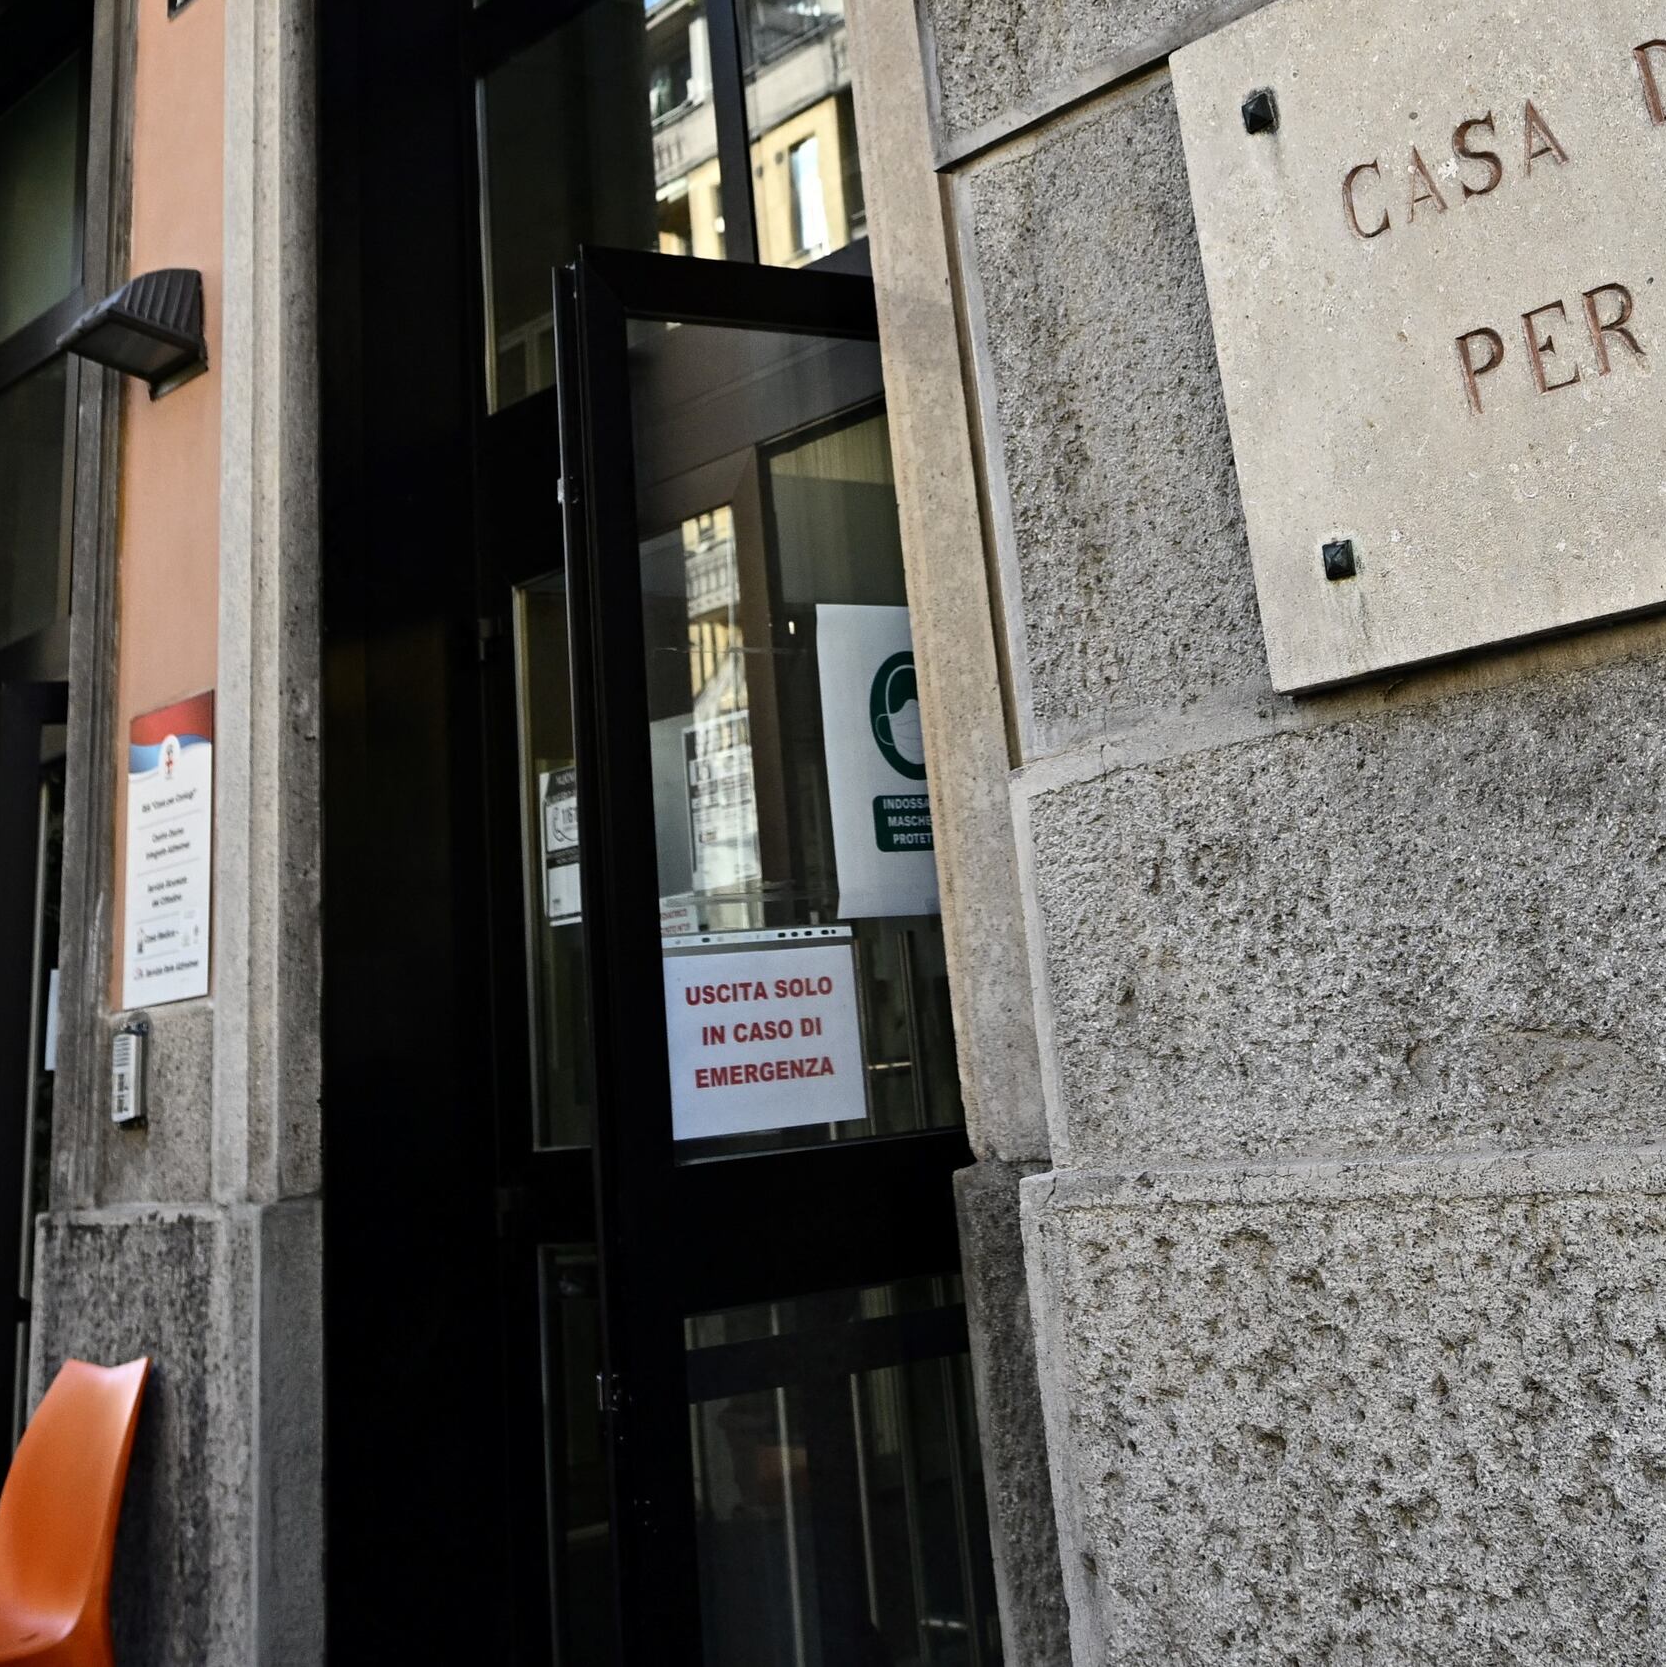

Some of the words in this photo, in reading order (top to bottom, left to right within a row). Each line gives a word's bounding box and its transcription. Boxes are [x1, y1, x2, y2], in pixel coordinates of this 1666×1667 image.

[1341, 99, 1570, 240] CASA
[1454, 281, 1647, 414] PER
[685, 981, 769, 1006] USCITA
[774, 976, 833, 999] SOLO
[702, 1025, 726, 1046] IN
[733, 1019, 793, 1043] CASO
[800, 1017, 822, 1038] DI
[695, 1056, 835, 1089] EMERGENZA
